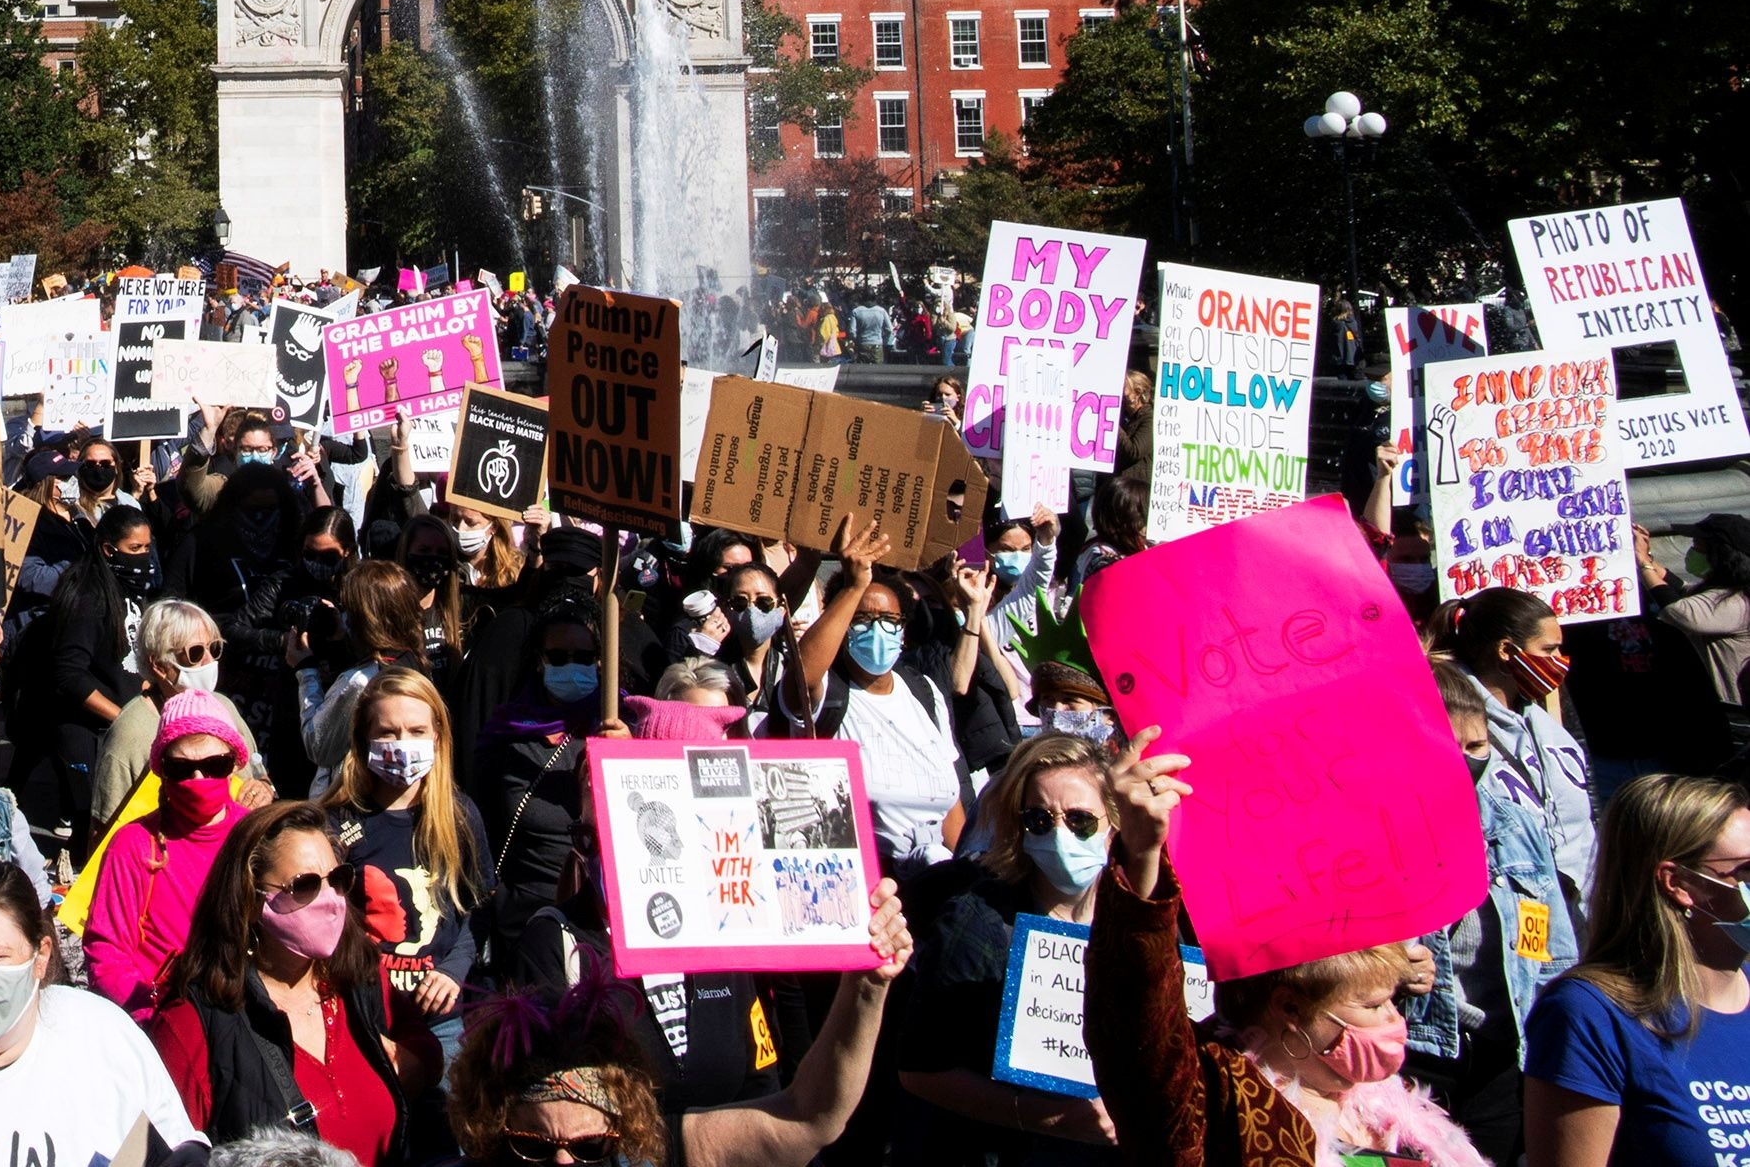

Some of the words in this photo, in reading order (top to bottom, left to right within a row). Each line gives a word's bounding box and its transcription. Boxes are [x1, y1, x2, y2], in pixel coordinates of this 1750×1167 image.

[1529, 210, 1612, 259] PHOTO
[1623, 204, 1652, 244] OF
[1011, 236, 1111, 290] MY
[1543, 251, 1697, 305] REPUBLICAN
[117, 280, 150, 296] WE'RE
[153, 281, 174, 296] NOT
[177, 280, 205, 297] HERE
[1166, 280, 1194, 301] What
[328, 316, 394, 343] GRAB
[401, 302, 445, 326] HIM
[452, 294, 483, 317] BY
[564, 290, 666, 344] Trump/
[986, 283, 1128, 340] BODY
[1172, 300, 1183, 320] is
[1198, 288, 1313, 340] ORANGE
[1577, 294, 1704, 340] INTEGRITY
[141, 324, 165, 340] NO
[338, 337, 384, 360] THE
[390, 314, 478, 347] BALLOT
[1164, 323, 1182, 341] on
[567, 331, 660, 380] Pence
[1162, 339, 1185, 361] the
[72, 376, 98, 395] IS
[1160, 361, 1302, 413] HOLLOW
[1451, 375, 1474, 411] I
[1511, 365, 1546, 402] NO
[571, 373, 657, 441] OUT
[748, 395, 764, 440] amazon
[1160, 402, 1179, 419] on
[1618, 411, 1688, 442] SCOTUS
[1691, 404, 1731, 428] VOTE
[469, 413, 494, 429] BLACK
[495, 420, 515, 434] LIVES
[516, 424, 544, 443] MATTER
[848, 416, 864, 461] amazon
[1157, 420, 1182, 436] the
[413, 444, 450, 461] PLANET
[708, 433, 726, 478] tomato
[725, 435, 740, 485] seafood
[777, 446, 789, 464] pet
[1158, 443, 1181, 460] and
[1638, 438, 1676, 460] 2020
[555, 430, 672, 510] NOW!
[757, 443, 773, 489] organic
[773, 465, 786, 497] food
[807, 453, 824, 502] diapers
[822, 457, 839, 502] orange
[1155, 460, 1182, 482] gets
[1181, 442, 1270, 487] THROWN
[1272, 452, 1308, 494] OUT
[702, 479, 717, 515] sauce
[858, 464, 874, 508] apples
[876, 467, 890, 507] paper
[892, 472, 909, 515] bagels
[1153, 482, 1177, 498] the
[751, 491, 764, 524] eggs
[818, 503, 834, 536] juice
[904, 475, 924, 549] cucumbers
[1150, 498, 1186, 514] week
[1157, 511, 1171, 531] of
[1131, 605, 1356, 698] Vote
[697, 758, 738, 768] BLACK
[699, 767, 739, 777] LIVES
[621, 775, 643, 789] HER
[644, 774, 679, 790] RIGHTS
[699, 775, 742, 787] MATTER
[715, 831, 740, 853] I'M
[639, 866, 685, 885] UNITE
[711, 857, 753, 878] WITH
[651, 901, 674, 917] JUSTICE
[720, 880, 755, 907] HER
[659, 921, 679, 931] PEACE
[1031, 970, 1042, 984] in
[1051, 974, 1085, 994] ALL
[1026, 997, 1084, 1026] decisions
